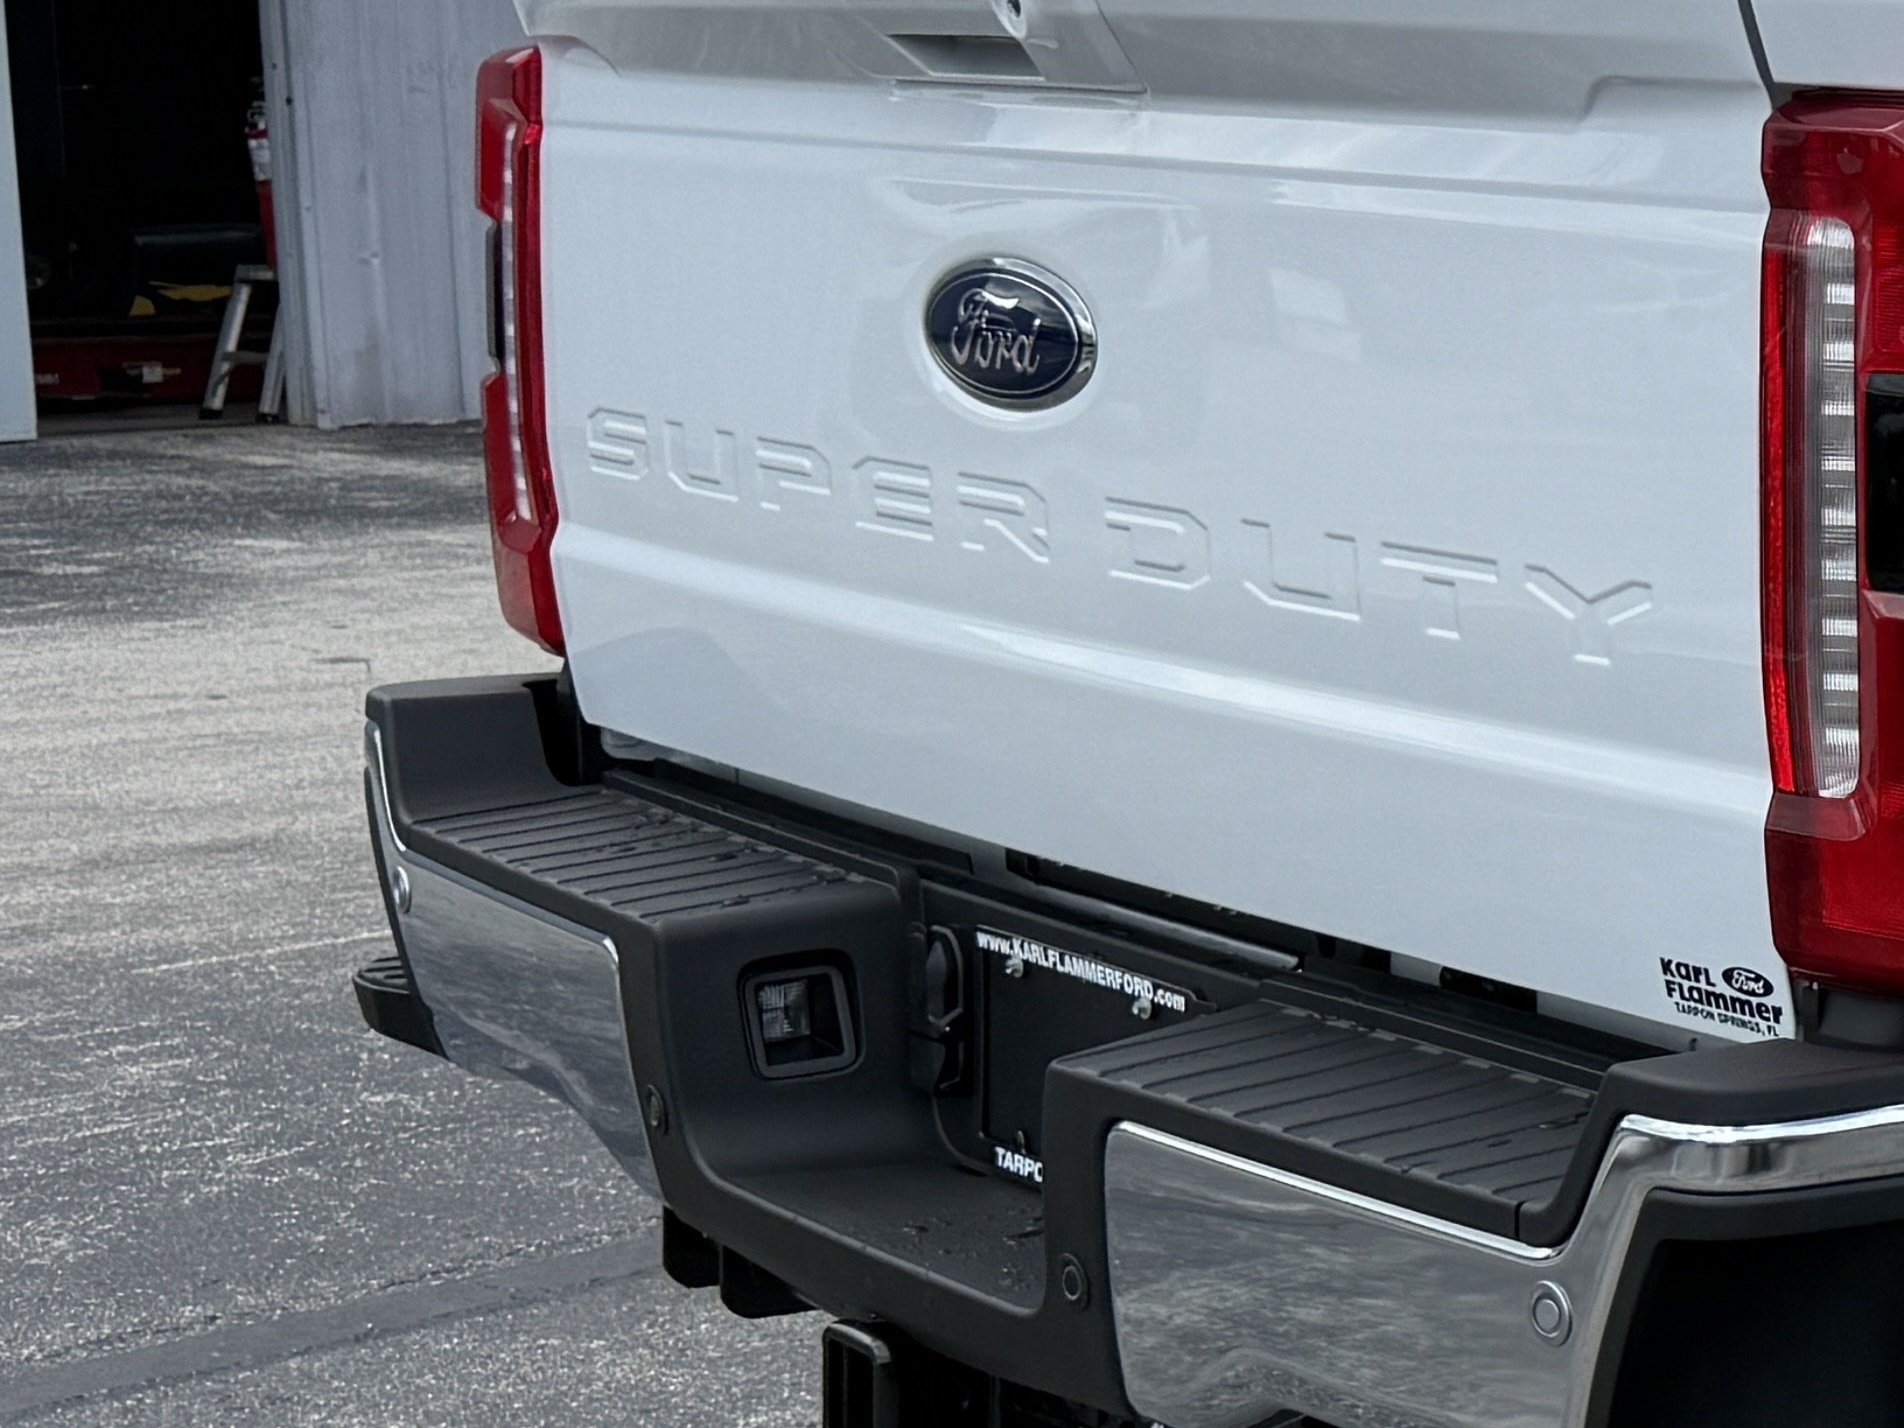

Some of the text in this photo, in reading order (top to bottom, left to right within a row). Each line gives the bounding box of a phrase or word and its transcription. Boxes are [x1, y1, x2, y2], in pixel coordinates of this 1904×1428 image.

[950, 287, 1041, 376] Ford
[585, 407, 1655, 667] SUPER DUTY
[975, 930, 1186, 1013] www.KARLFLAMMERFORD.com
[994, 1145, 1043, 1183] TARPO
